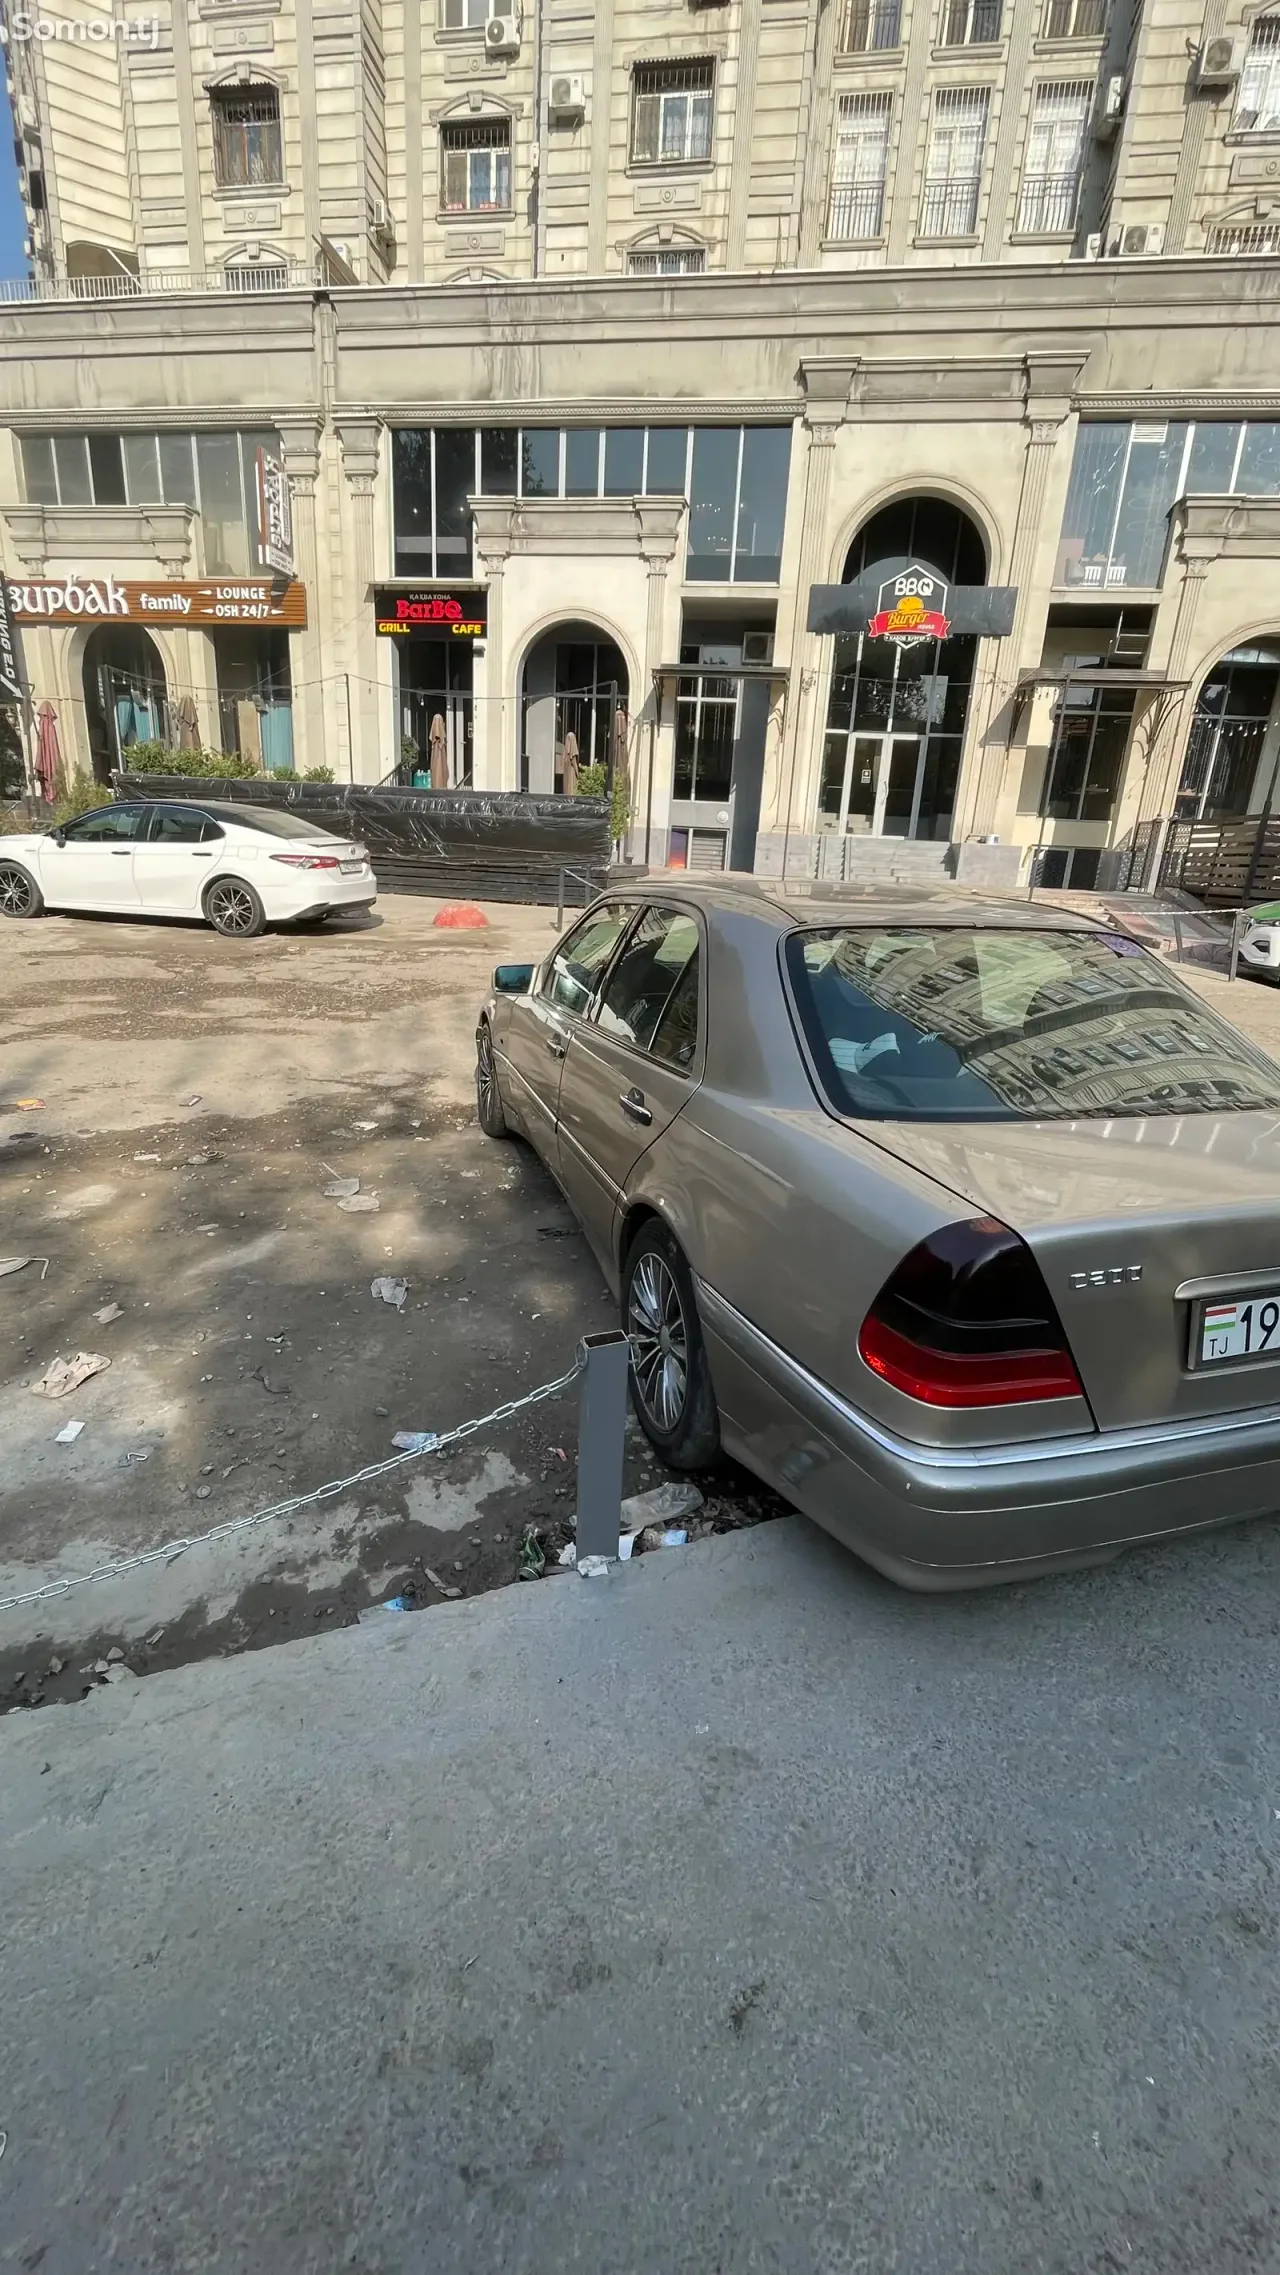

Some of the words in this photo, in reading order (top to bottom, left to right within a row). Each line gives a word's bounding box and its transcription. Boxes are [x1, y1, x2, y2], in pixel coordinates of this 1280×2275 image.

[216, 587, 267, 600] LOUNGE
[894, 577, 934, 596] BBQ
[140, 593, 191, 615] family
[215, 604, 239, 617] OSH
[241, 603, 269, 619] 24/7
[396, 600, 463, 618] BarBQ
[379, 623, 410, 633] GRILL
[452, 624, 481, 634] CAFE
[887, 611, 930, 628] Burger
[3, 652, 16, 679] 2.0
[1240, 1301, 1279, 1352] 19
[1209, 1337, 1229, 1357] TJ
